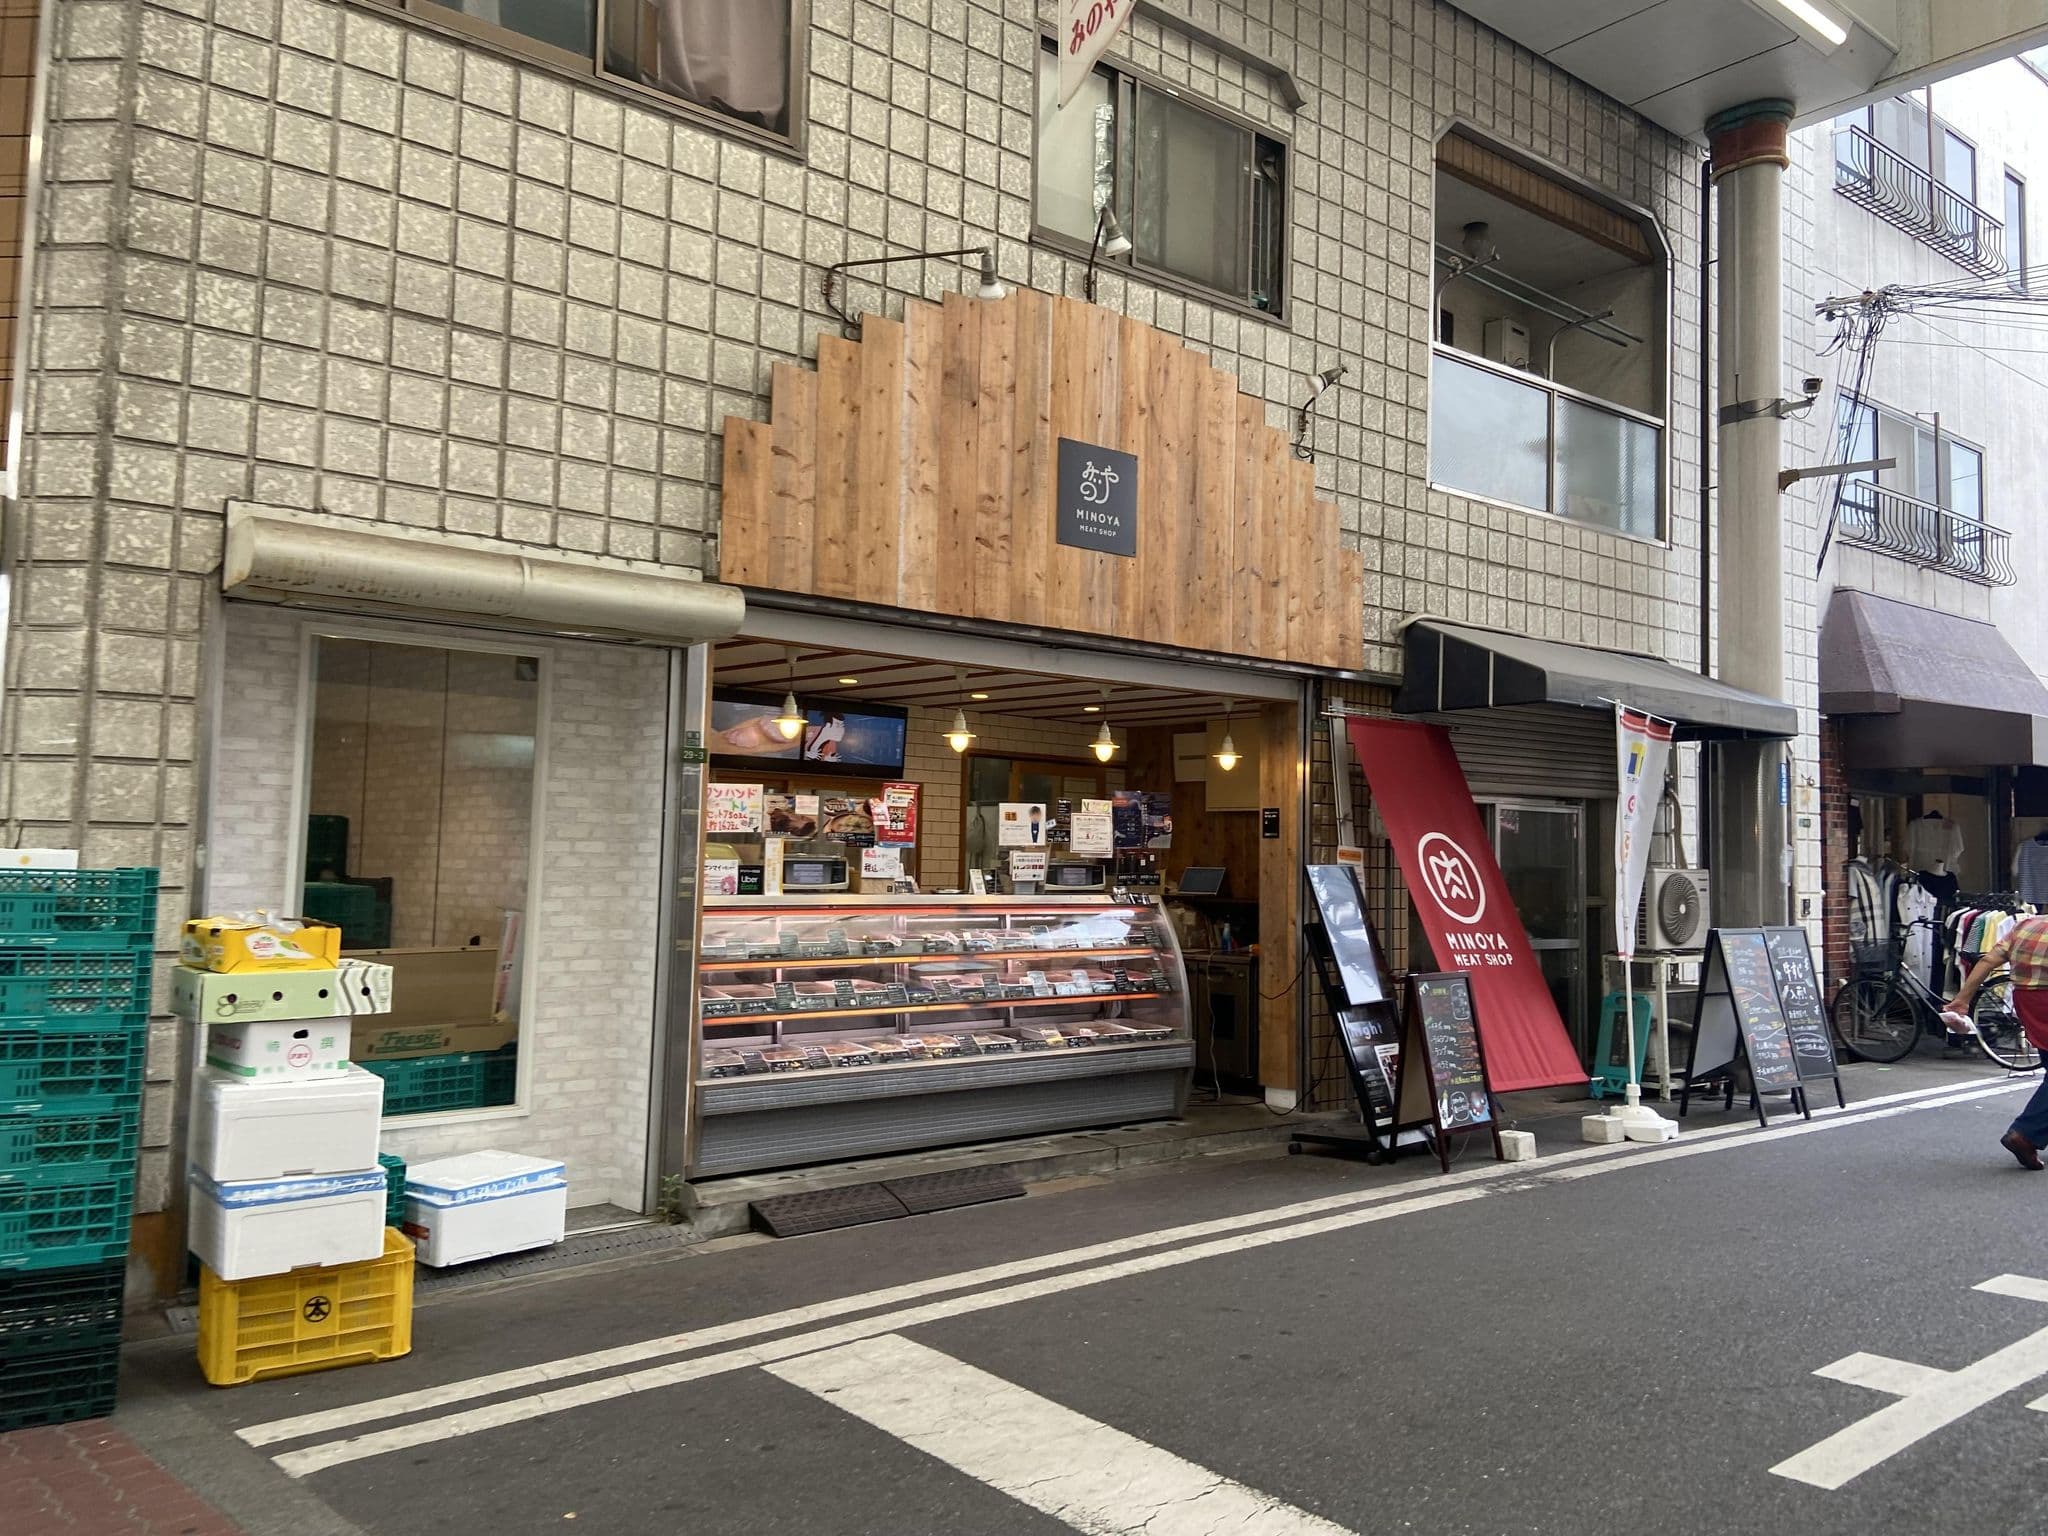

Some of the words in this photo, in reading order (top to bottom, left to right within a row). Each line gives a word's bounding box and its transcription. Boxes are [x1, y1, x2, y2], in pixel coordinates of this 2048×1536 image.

[1076, 508, 1120, 527] MINOYA
[1079, 524, 1097, 534] MEAT
[1099, 528, 1117, 537] SHOP
[683, 750, 705, 760] 29-3
[741, 875, 759, 883] Uber
[1445, 932, 1509, 950] MINOYA
[1453, 953, 1482, 966] MEAT
[1484, 953, 1513, 966] SHOP
